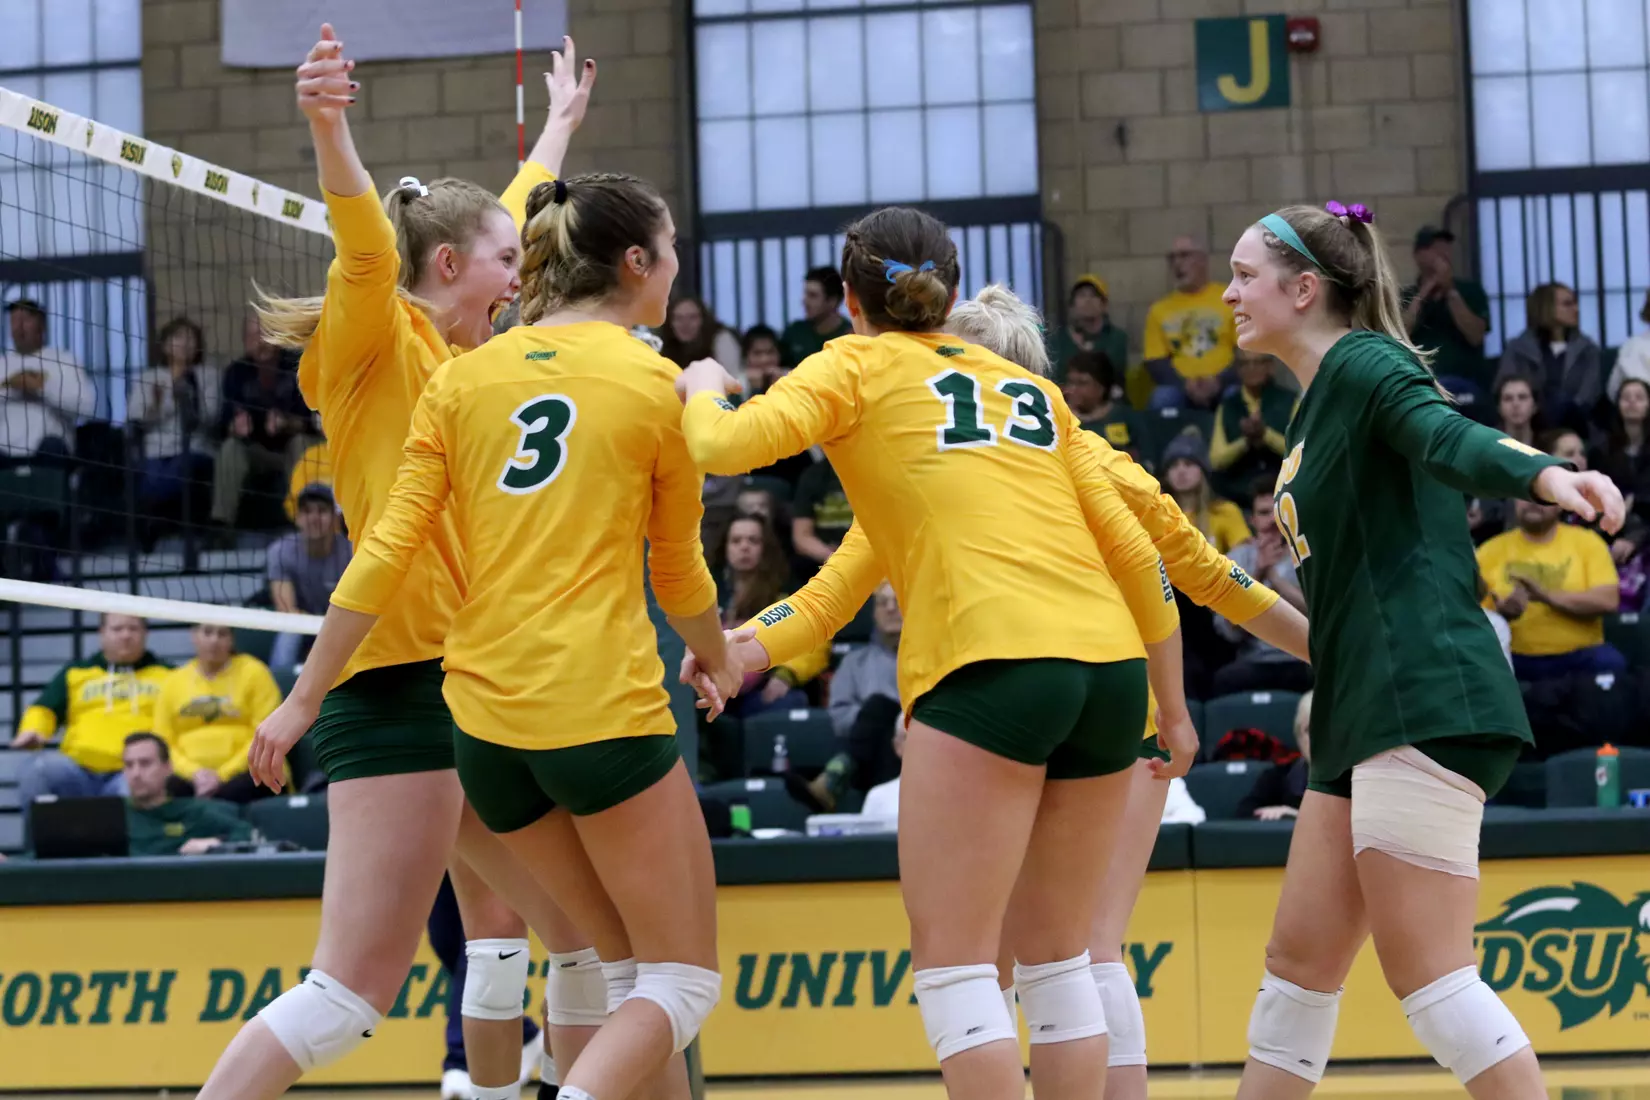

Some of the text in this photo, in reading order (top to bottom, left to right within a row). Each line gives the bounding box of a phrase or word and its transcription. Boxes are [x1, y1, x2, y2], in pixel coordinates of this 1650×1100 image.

[1218, 20, 1270, 103] J
[497, 394, 576, 493] 3
[925, 369, 1058, 450] 13
[757, 602, 796, 627] BISON
[0, 968, 178, 1027] ORTH
[198, 964, 452, 1022] DATA
[1474, 930, 1630, 993] DSU
